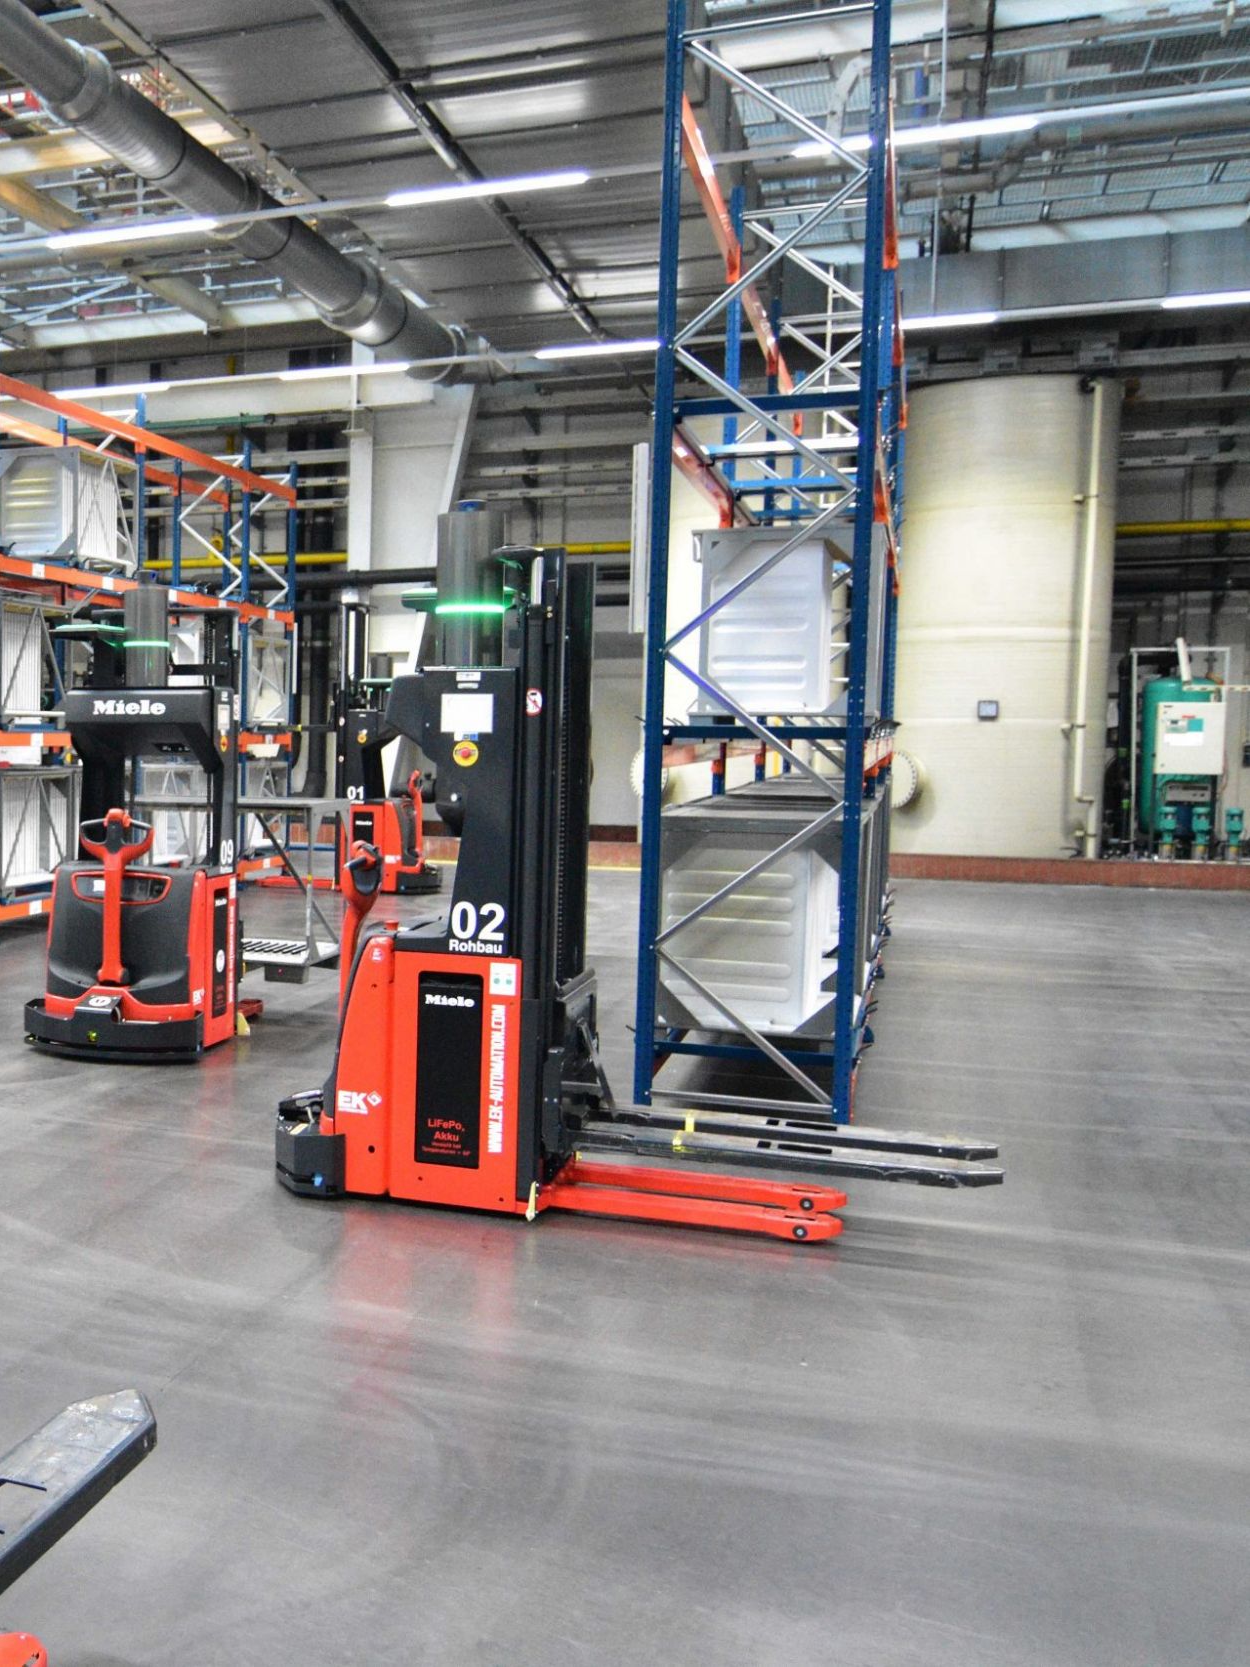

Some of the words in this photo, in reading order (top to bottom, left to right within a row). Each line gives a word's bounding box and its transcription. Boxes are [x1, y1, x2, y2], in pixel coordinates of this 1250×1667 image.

[93, 699, 166, 715] Miele
[347, 785, 364, 800] 01
[220, 839, 234, 865] 09
[451, 901, 505, 941] 02
[448, 939, 503, 954] Rohbau
[425, 994, 475, 1007] Miele
[338, 1090, 368, 1111] EK
[434, 1131, 459, 1142] Akku
